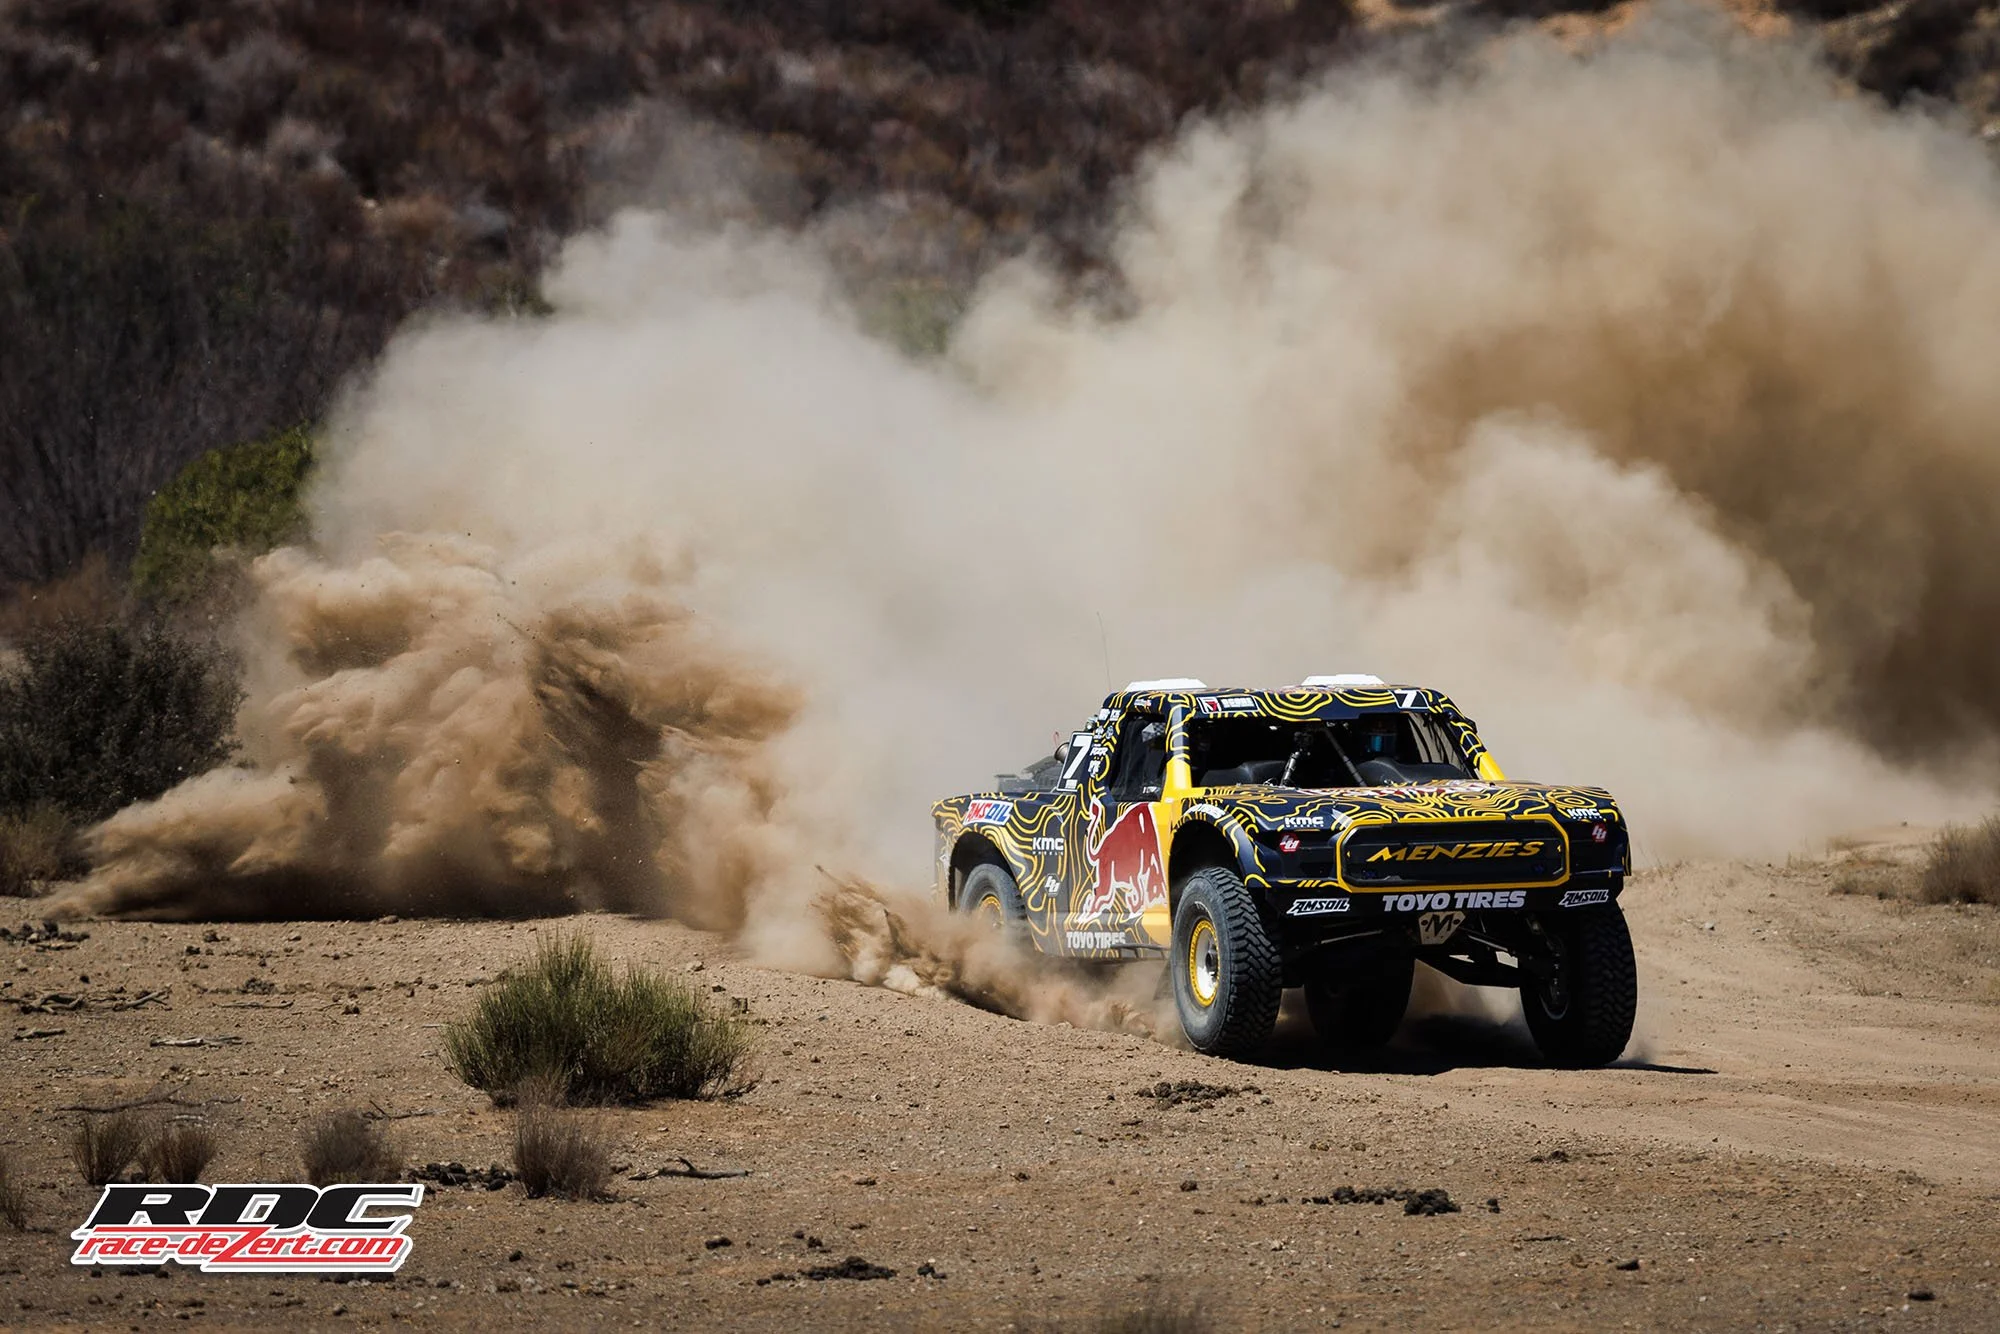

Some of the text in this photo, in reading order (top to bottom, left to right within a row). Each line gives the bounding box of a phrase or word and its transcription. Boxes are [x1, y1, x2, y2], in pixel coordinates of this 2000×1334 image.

[1394, 690, 1419, 708] 7
[1063, 735, 1093, 779] 7
[967, 802, 1010, 822] AMSOIL
[1366, 841, 1545, 862] MENZIES
[1287, 898, 1350, 914] AMSOIL
[1382, 891, 1527, 912] TOYO TIRES
[1559, 890, 1609, 907] AMSOIL
[1066, 932, 1126, 949] TOYO TIRES
